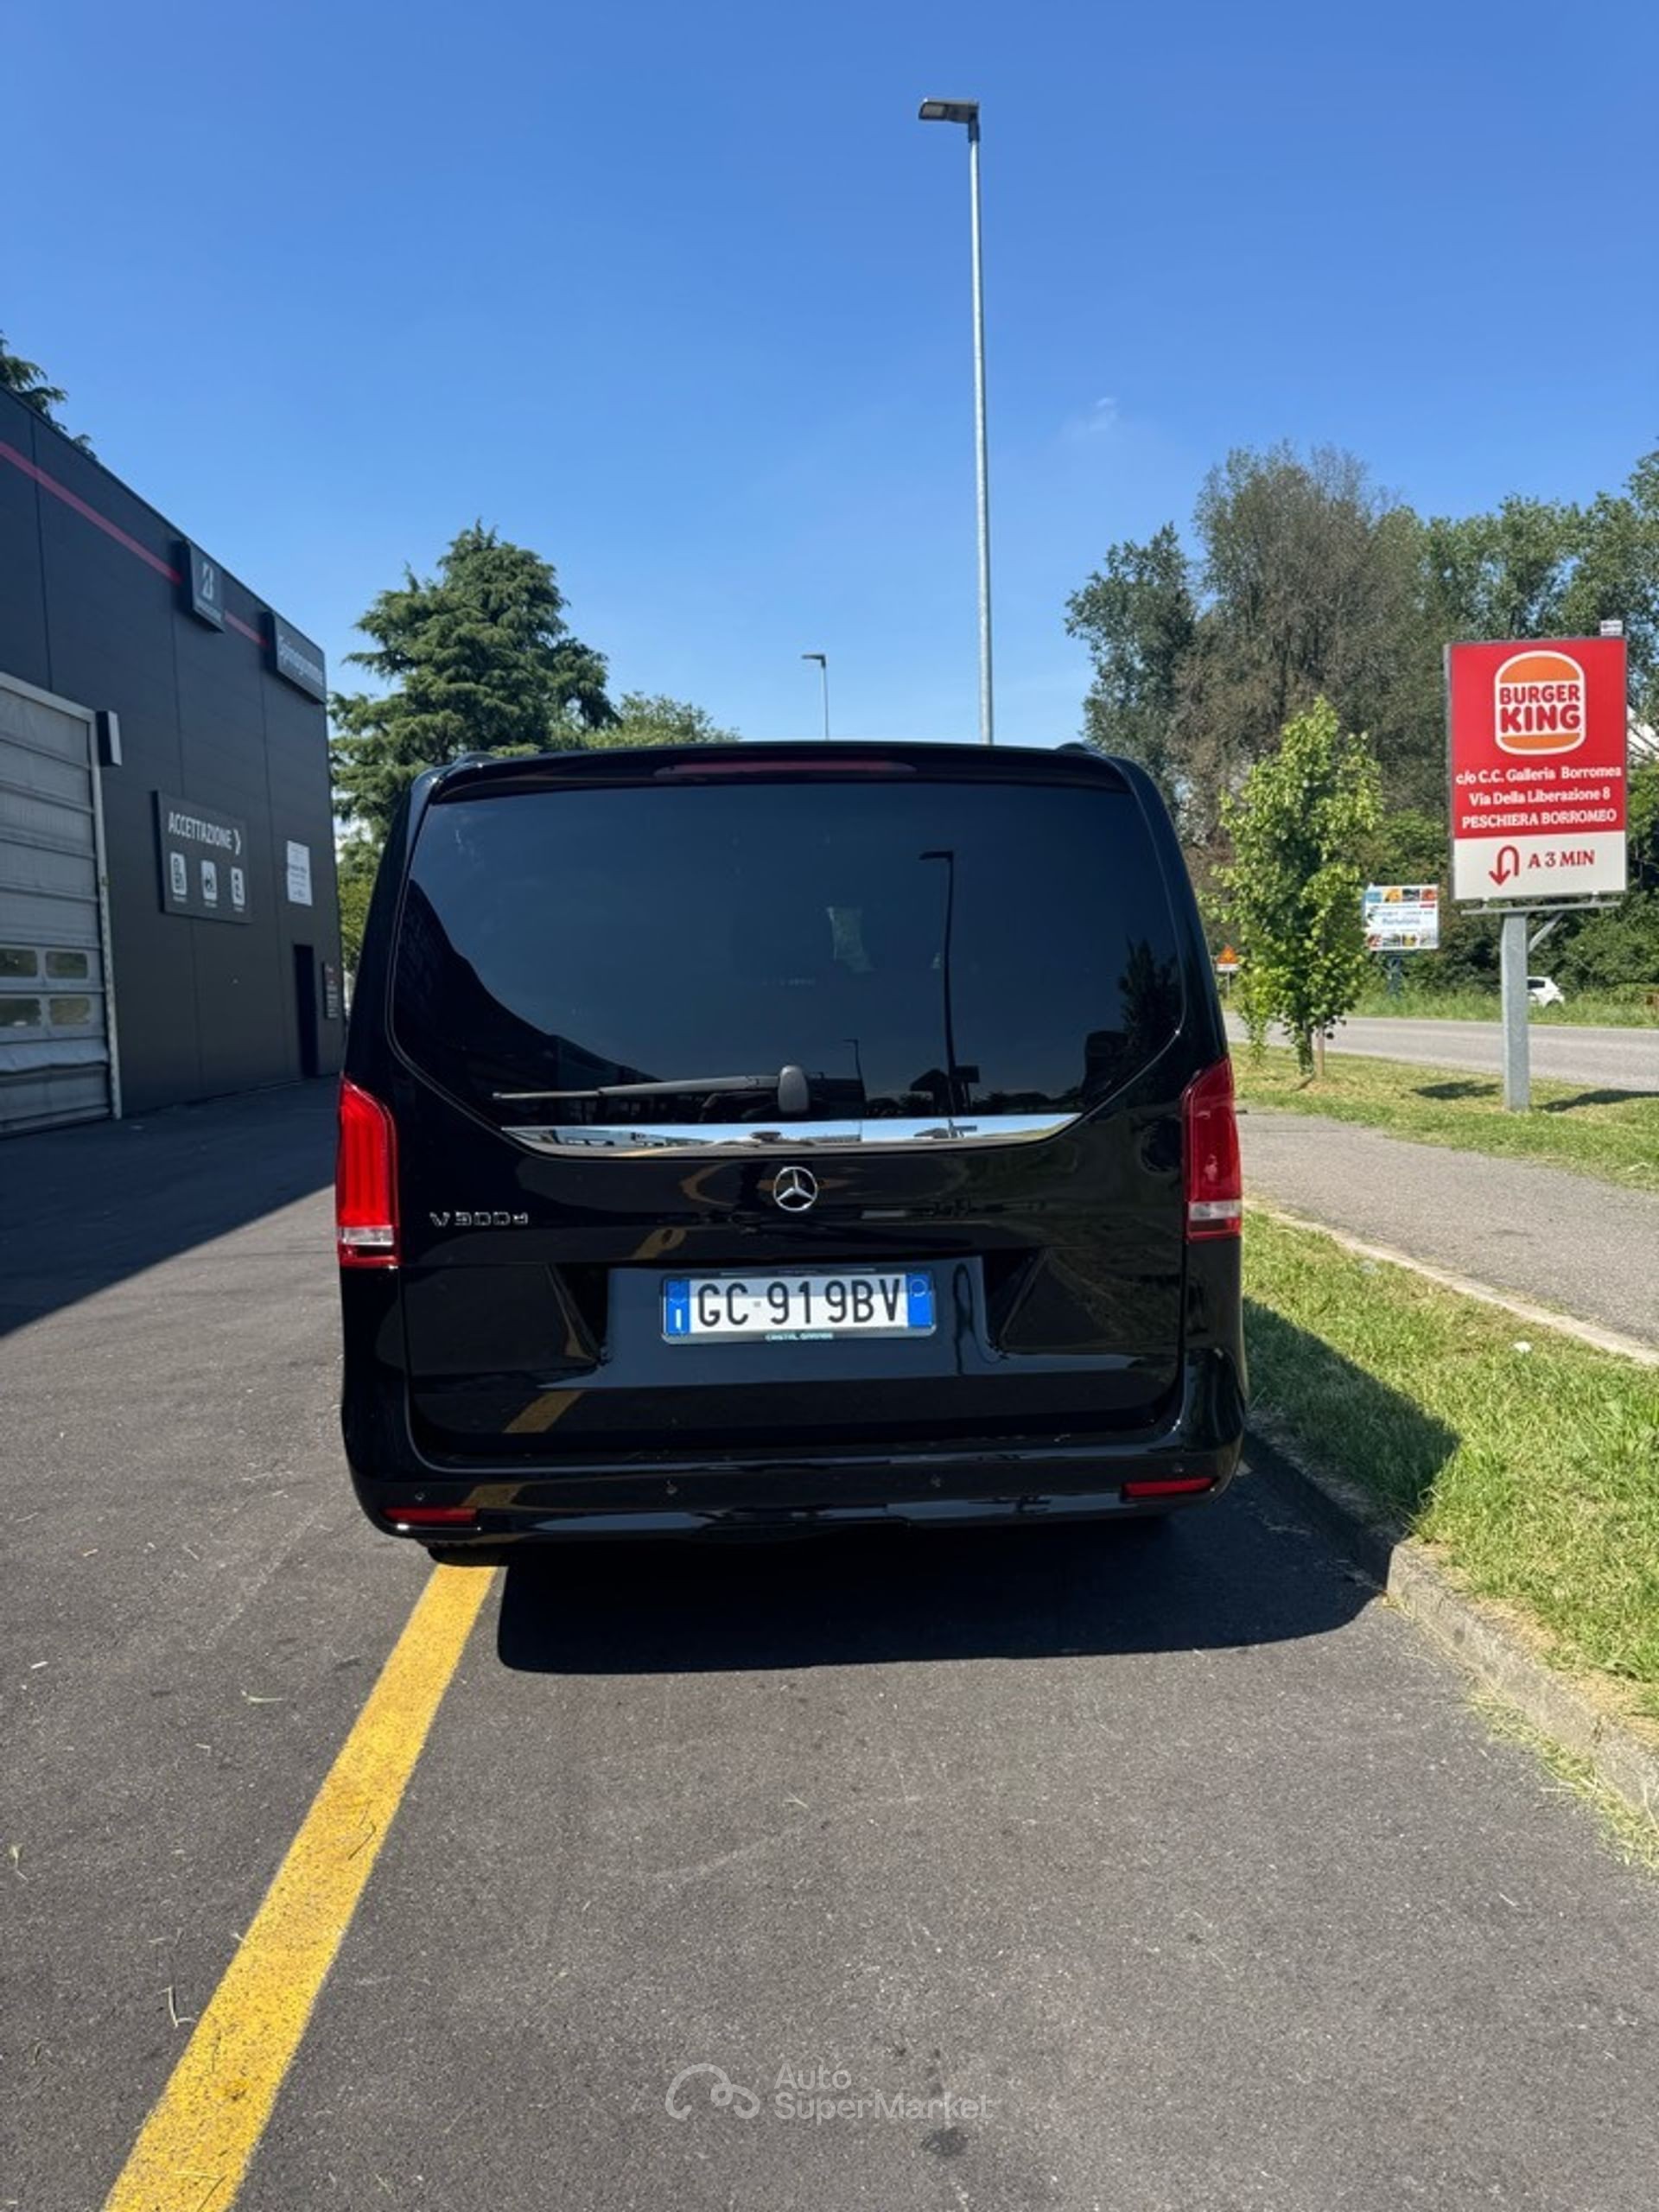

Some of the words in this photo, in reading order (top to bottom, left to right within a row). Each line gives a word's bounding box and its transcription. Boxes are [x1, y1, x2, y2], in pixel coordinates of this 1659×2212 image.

[1499, 683, 1580, 705] BURGER
[1500, 704, 1580, 733] KING
[1456, 770, 1476, 785] c/o
[1478, 769, 1504, 783] C.C.
[1506, 766, 1555, 782] Galleria
[1560, 766, 1622, 779] Borromea
[1469, 791, 1491, 806] Via
[1492, 790, 1525, 804] Della
[1528, 787, 1601, 804] Liberazione
[1602, 786, 1611, 800] 8
[1462, 812, 1539, 830] PESCHIERA
[1541, 808, 1618, 824] BORROMEO
[168, 811, 232, 850] ACCETTAZIONE
[1528, 853, 1541, 868] A
[1545, 851, 1556, 868] 3
[1560, 849, 1595, 867] MIN
[697, 1282, 749, 1327] GC
[766, 1278, 900, 1325] 919BV
